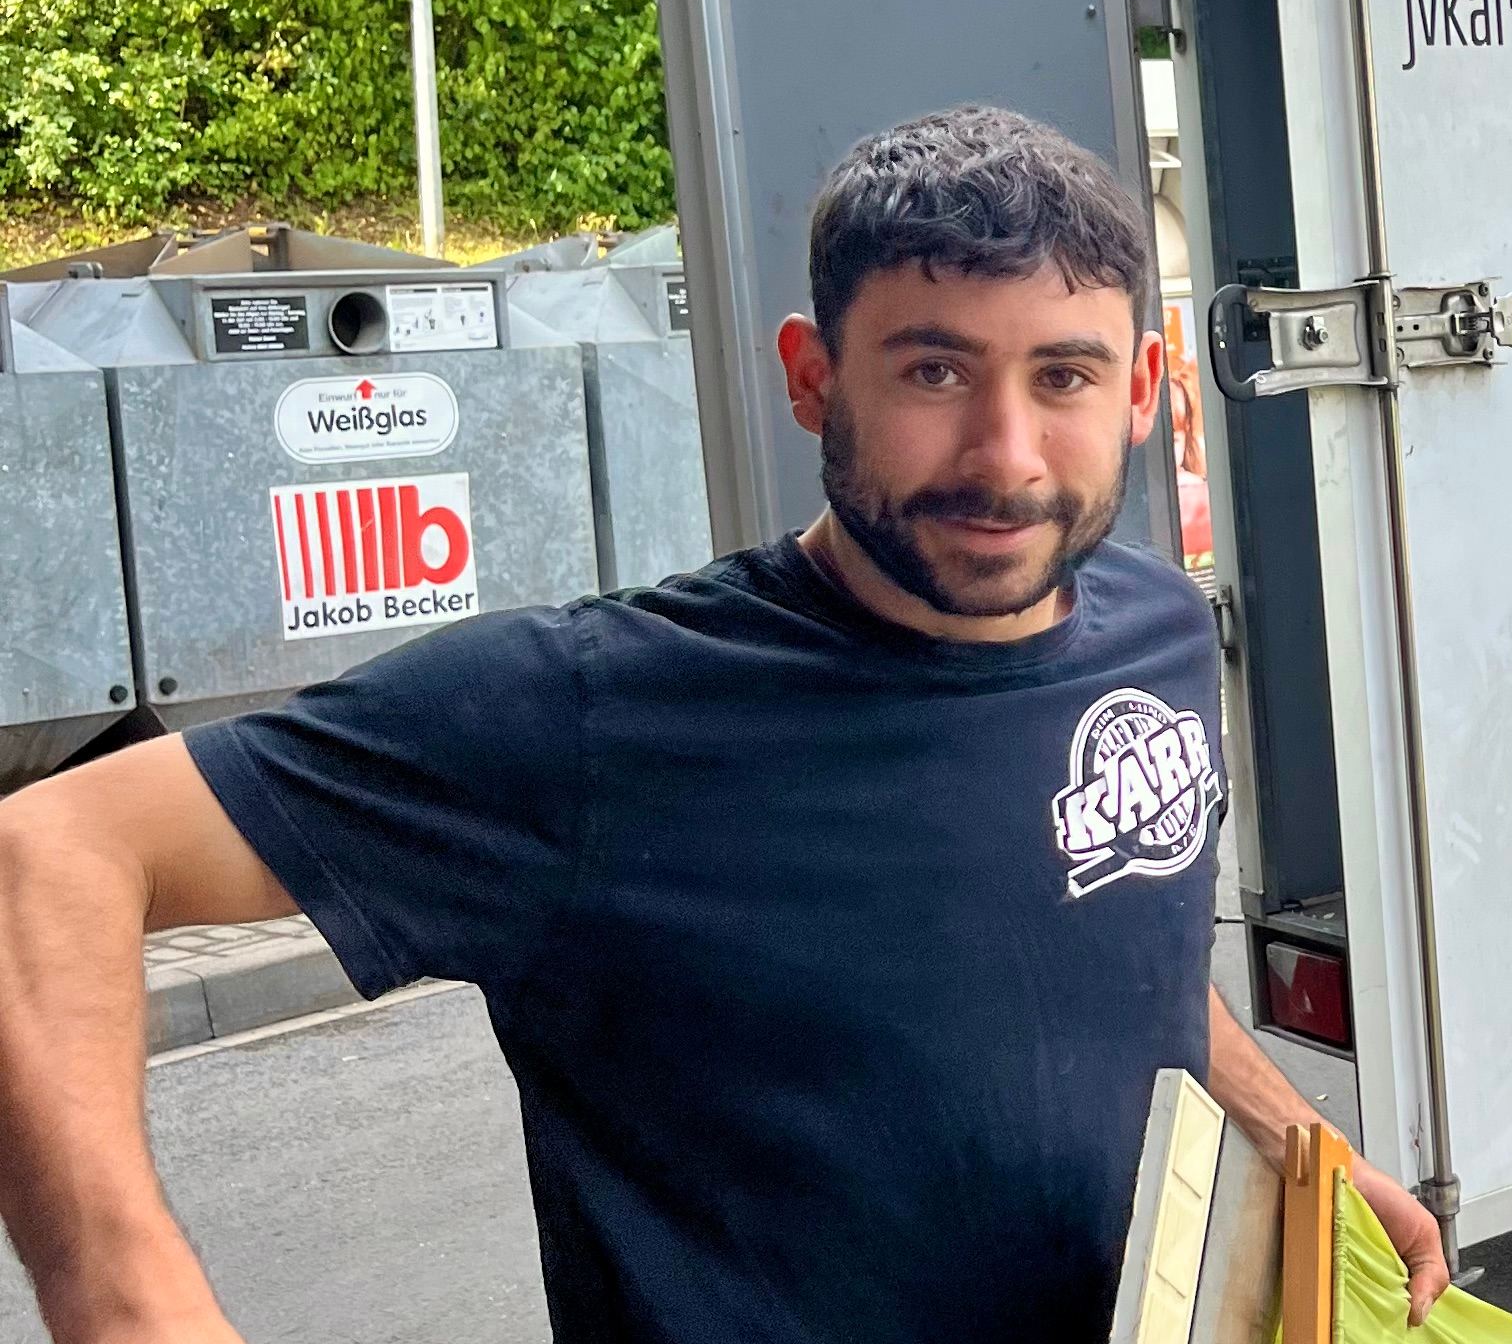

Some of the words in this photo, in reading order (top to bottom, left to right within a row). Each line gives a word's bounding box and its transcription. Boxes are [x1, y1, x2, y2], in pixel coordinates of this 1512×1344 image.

[307, 403, 428, 435] Weißglas
[288, 598, 373, 631] Jakob
[384, 589, 475, 619] Becker
[1060, 714, 1213, 855] KARR
